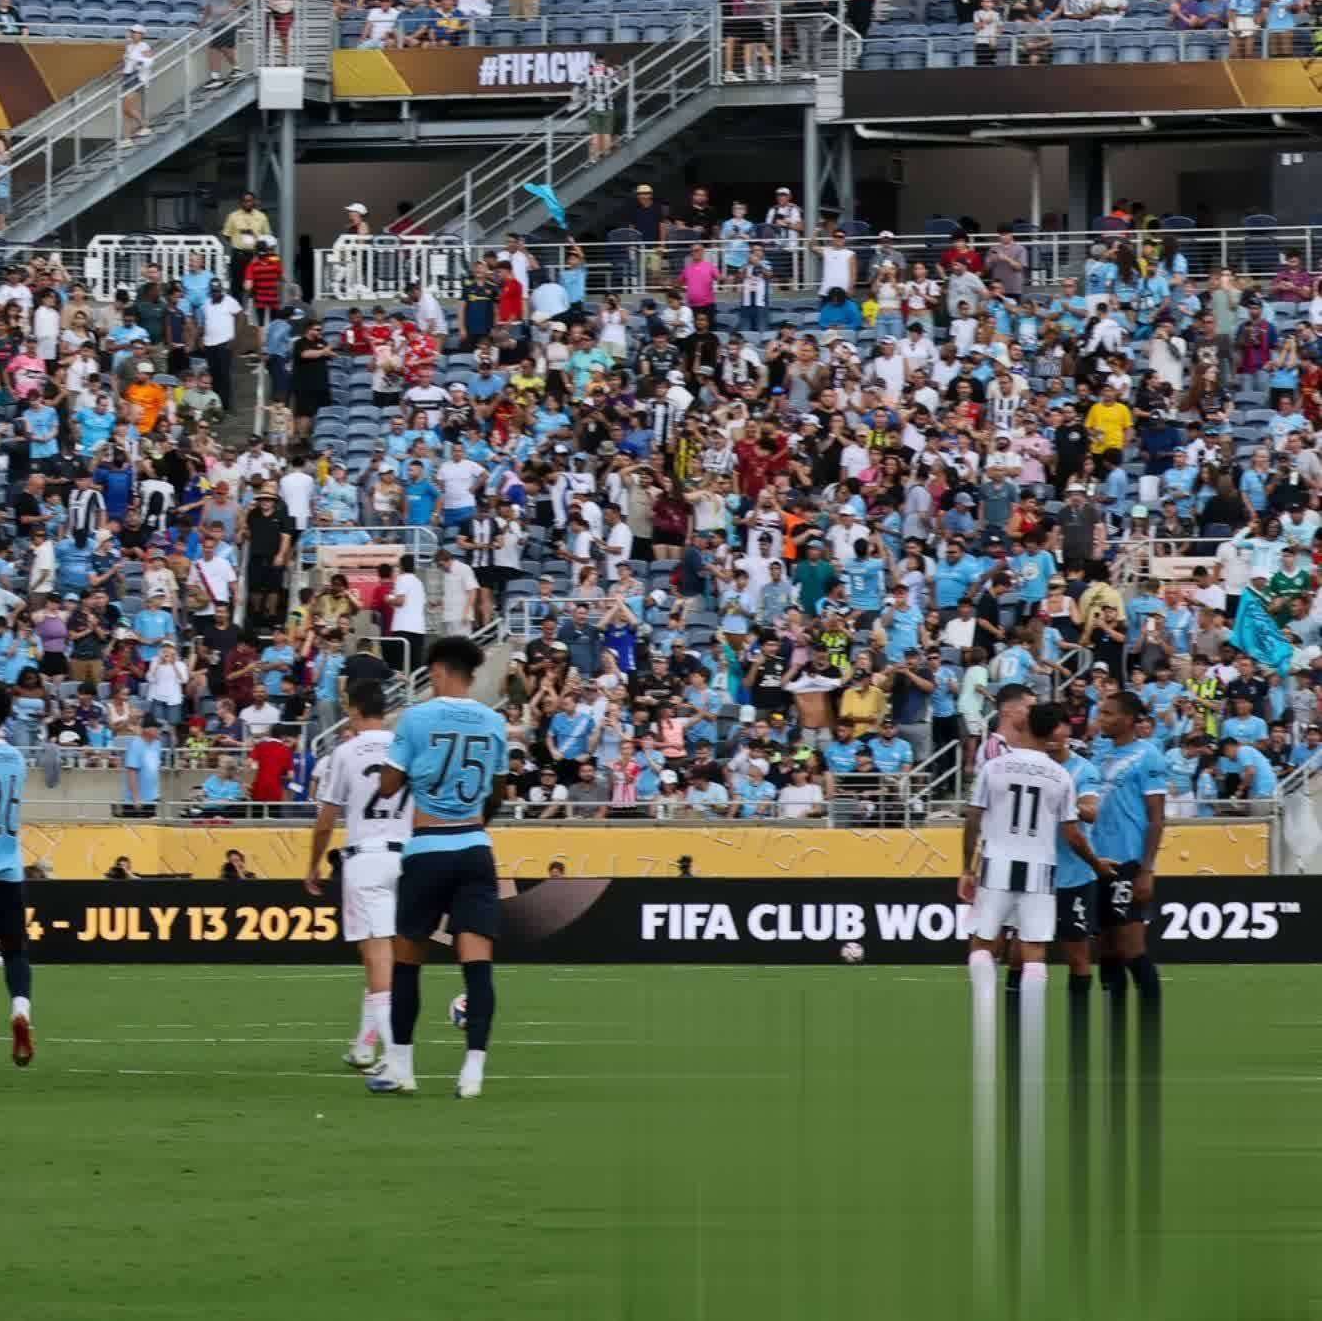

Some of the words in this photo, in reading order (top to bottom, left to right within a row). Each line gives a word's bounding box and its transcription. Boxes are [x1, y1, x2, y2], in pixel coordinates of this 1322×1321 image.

[478, 50, 591, 86] #FIFACW
[428, 732, 491, 805] 75
[1008, 782, 1042, 838] 11
[24, 906, 45, 941] 4
[76, 906, 180, 941] JULY
[186, 906, 228, 941] 13
[235, 906, 339, 941] 2025
[641, 904, 739, 940] FIFA
[747, 903, 866, 941] CLUB
[875, 904, 974, 940] WOR
